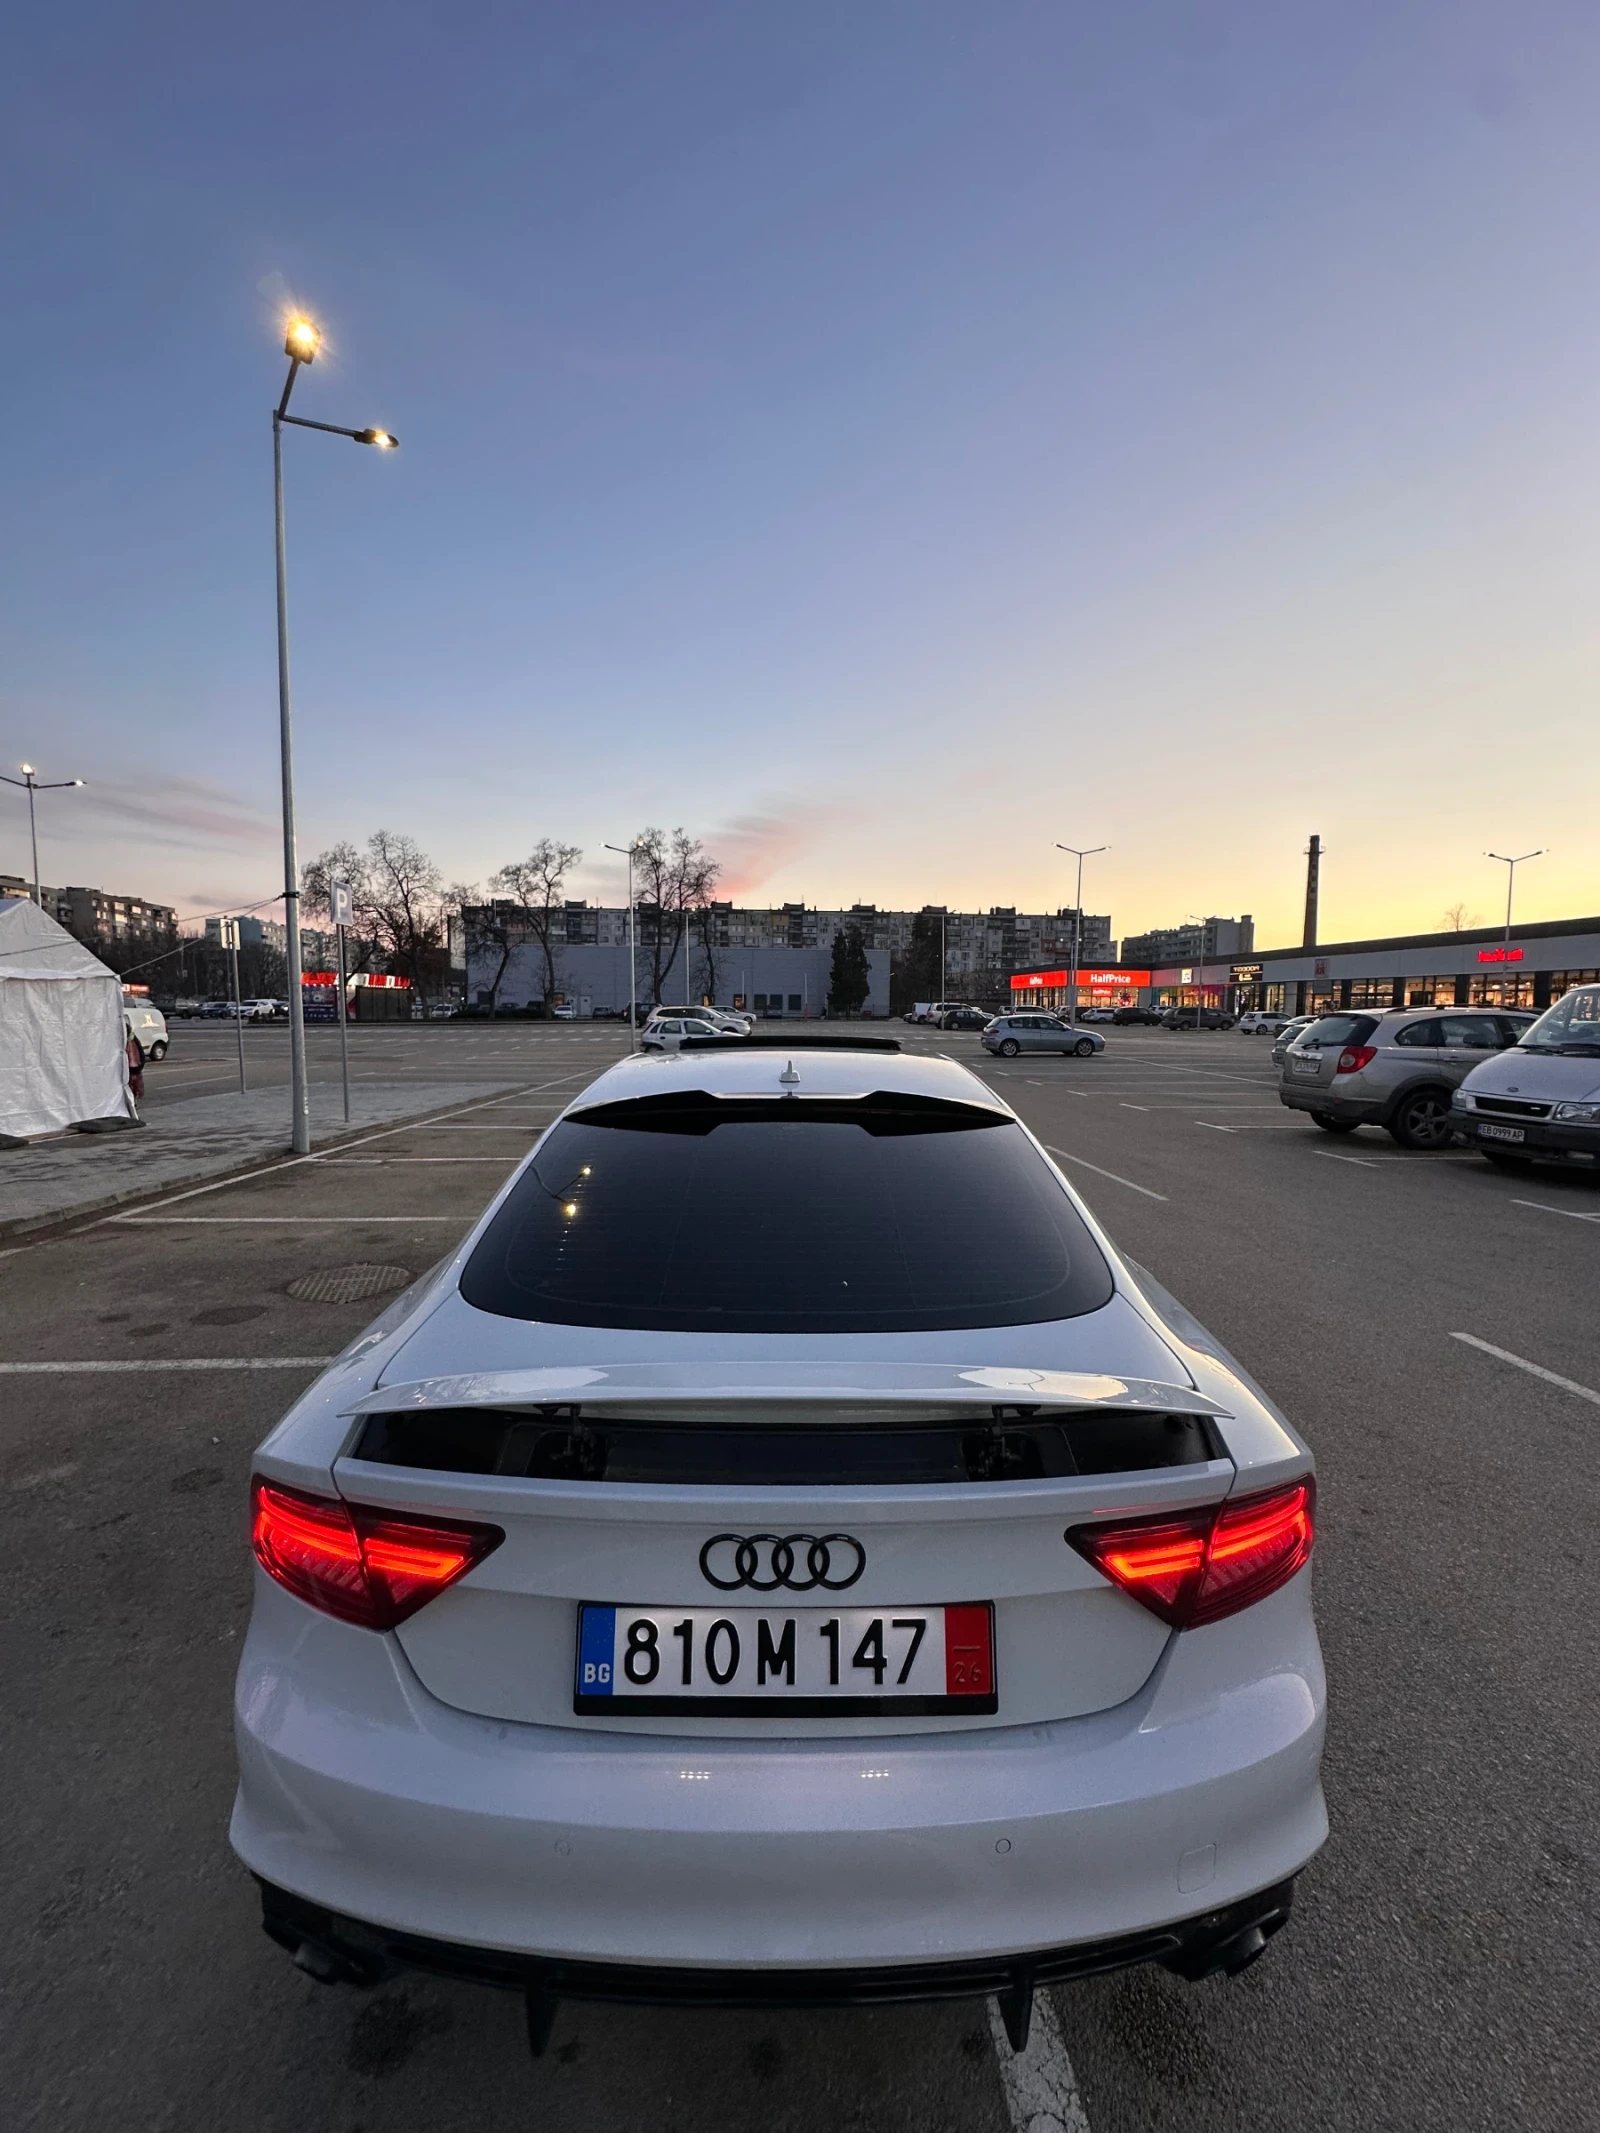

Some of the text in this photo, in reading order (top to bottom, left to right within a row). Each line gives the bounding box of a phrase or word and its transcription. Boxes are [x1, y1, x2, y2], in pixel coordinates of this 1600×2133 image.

[336, 888, 348, 918] P
[1090, 974, 1131, 983] HalfPrice
[623, 1618, 926, 1685] 810 M 147
[584, 1663, 611, 1683] BG
[954, 1661, 981, 1684] 26
